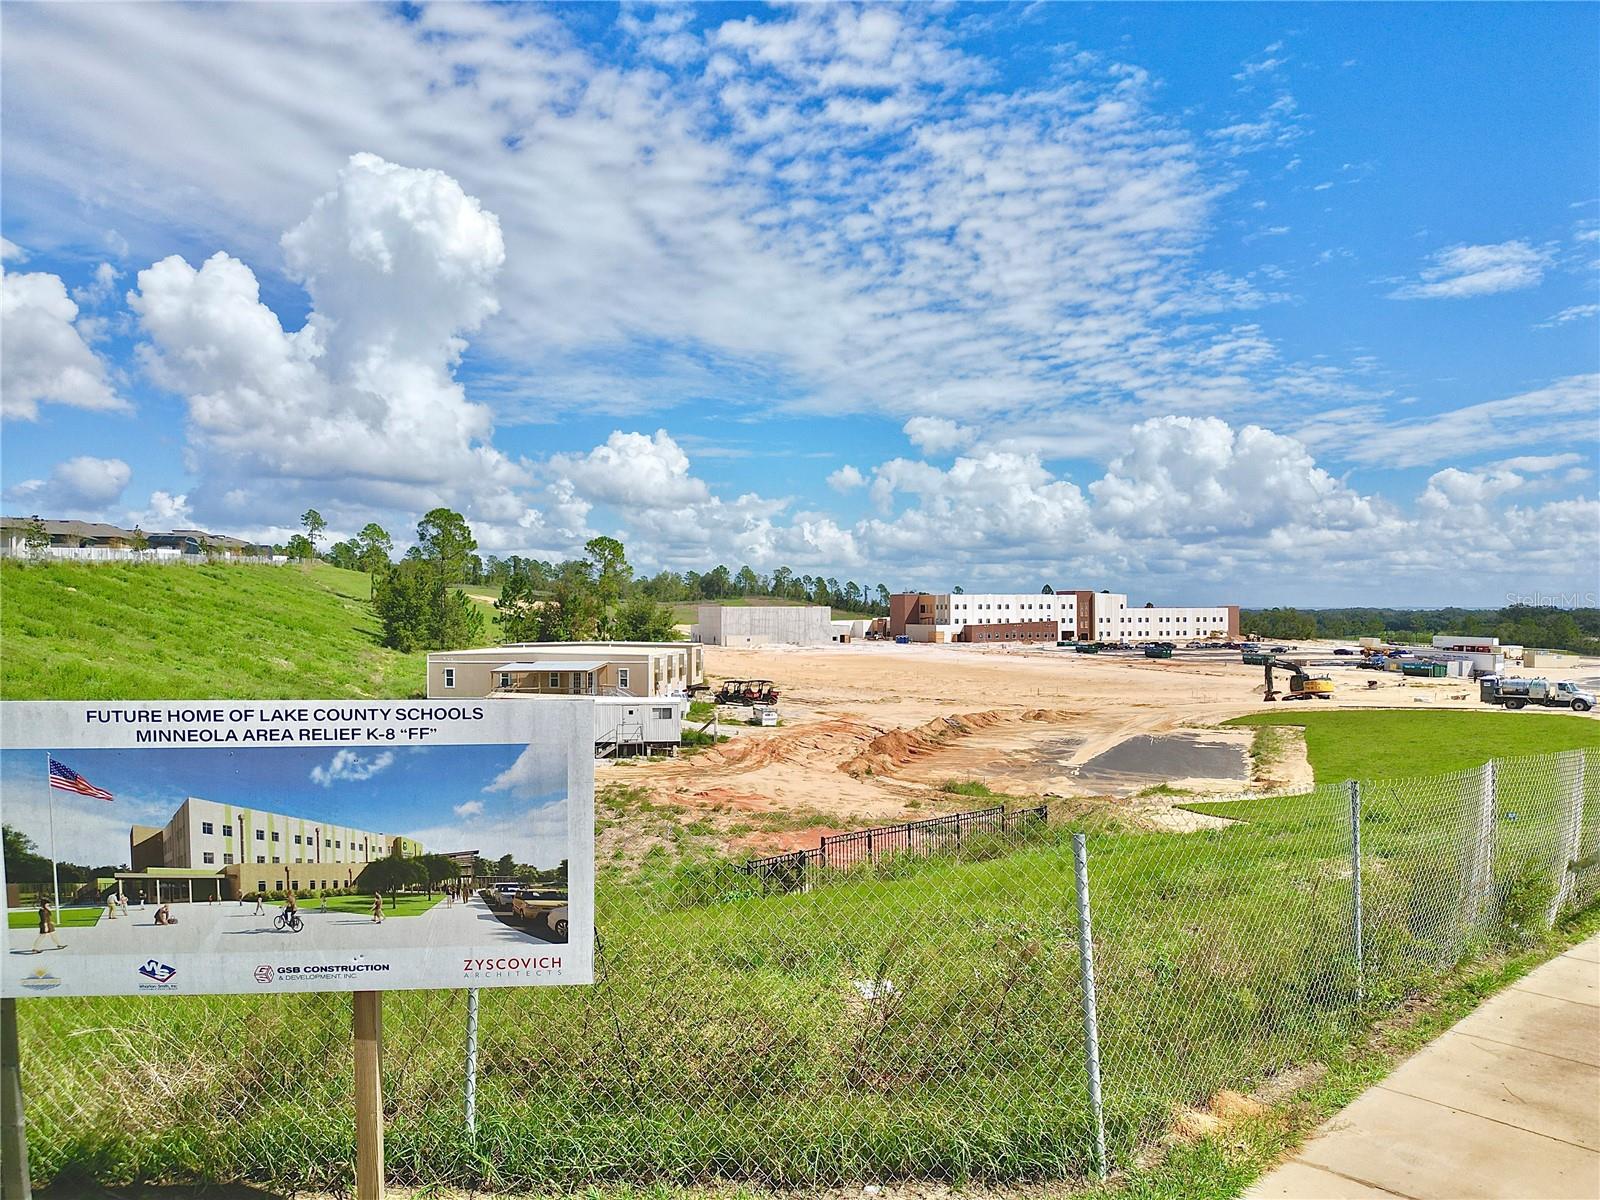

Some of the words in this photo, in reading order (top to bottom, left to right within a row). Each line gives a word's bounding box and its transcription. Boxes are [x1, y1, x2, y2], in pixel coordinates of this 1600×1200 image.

[86, 710, 163, 723] FUTURE
[167, 709, 225, 722] HOME
[229, 709, 255, 722] OF
[260, 709, 309, 722] LAKE
[313, 708, 391, 721] COUNTY
[395, 707, 484, 720] SCHOOLS
[136, 729, 238, 742] MINNEOLA
[242, 728, 294, 741] AREA
[299, 728, 362, 740] RELIEF
[366, 728, 396, 740] K-8
[303, 964, 390, 973] CONSTRUCTION
[463, 957, 562, 971] ZYSCOVICH
[463, 970, 562, 978] ARCHITECTS
